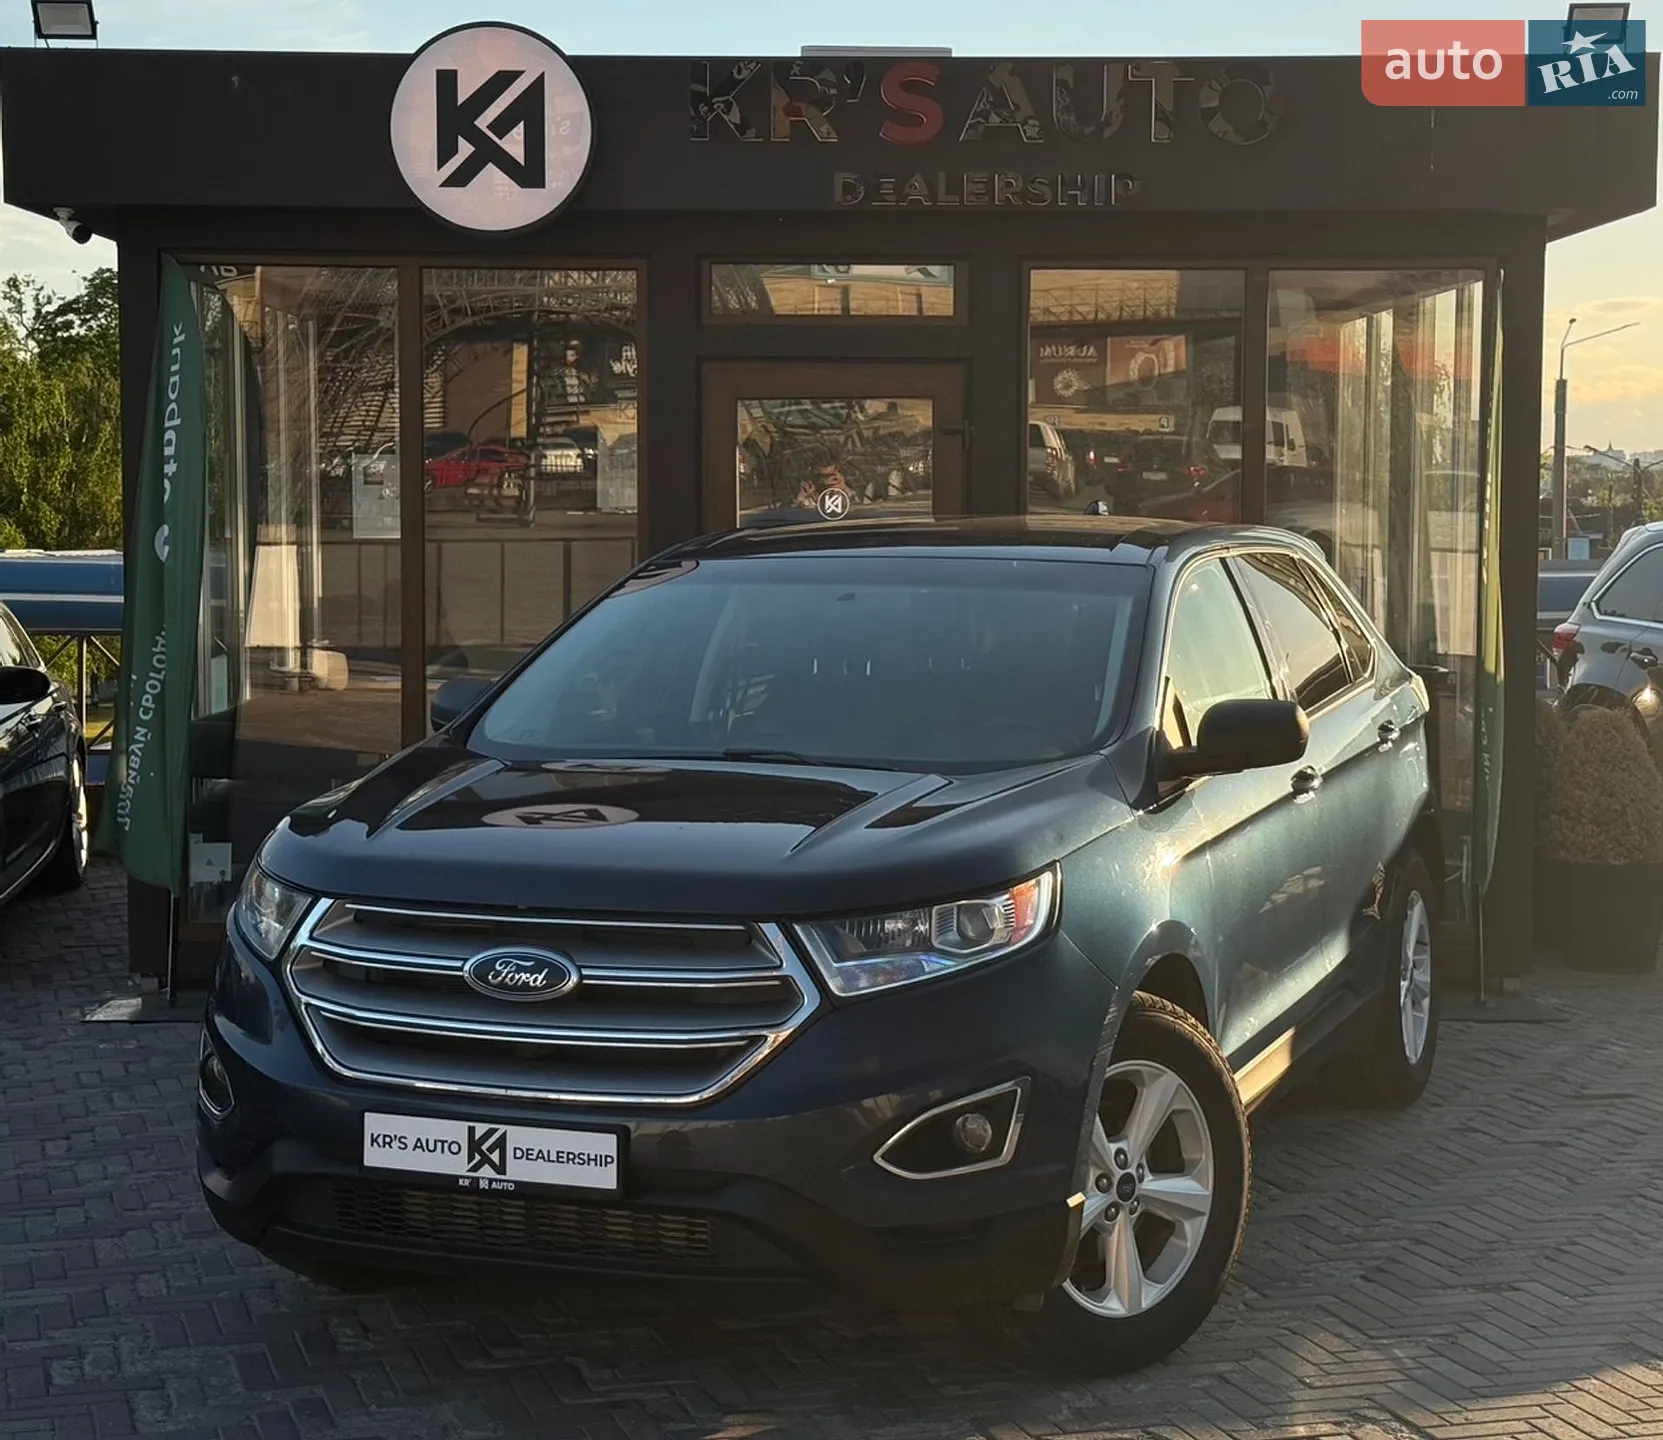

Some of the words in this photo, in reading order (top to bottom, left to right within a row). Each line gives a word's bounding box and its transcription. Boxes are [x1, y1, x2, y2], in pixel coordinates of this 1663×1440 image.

[831, 171, 1141, 207] DEALERSHIP
[488, 957, 548, 988] Ford
[370, 1132, 408, 1151] KR'S
[412, 1136, 462, 1156] AUTO
[512, 1146, 615, 1168] DEALERSHIP
[490, 1180, 515, 1191] AUTO
